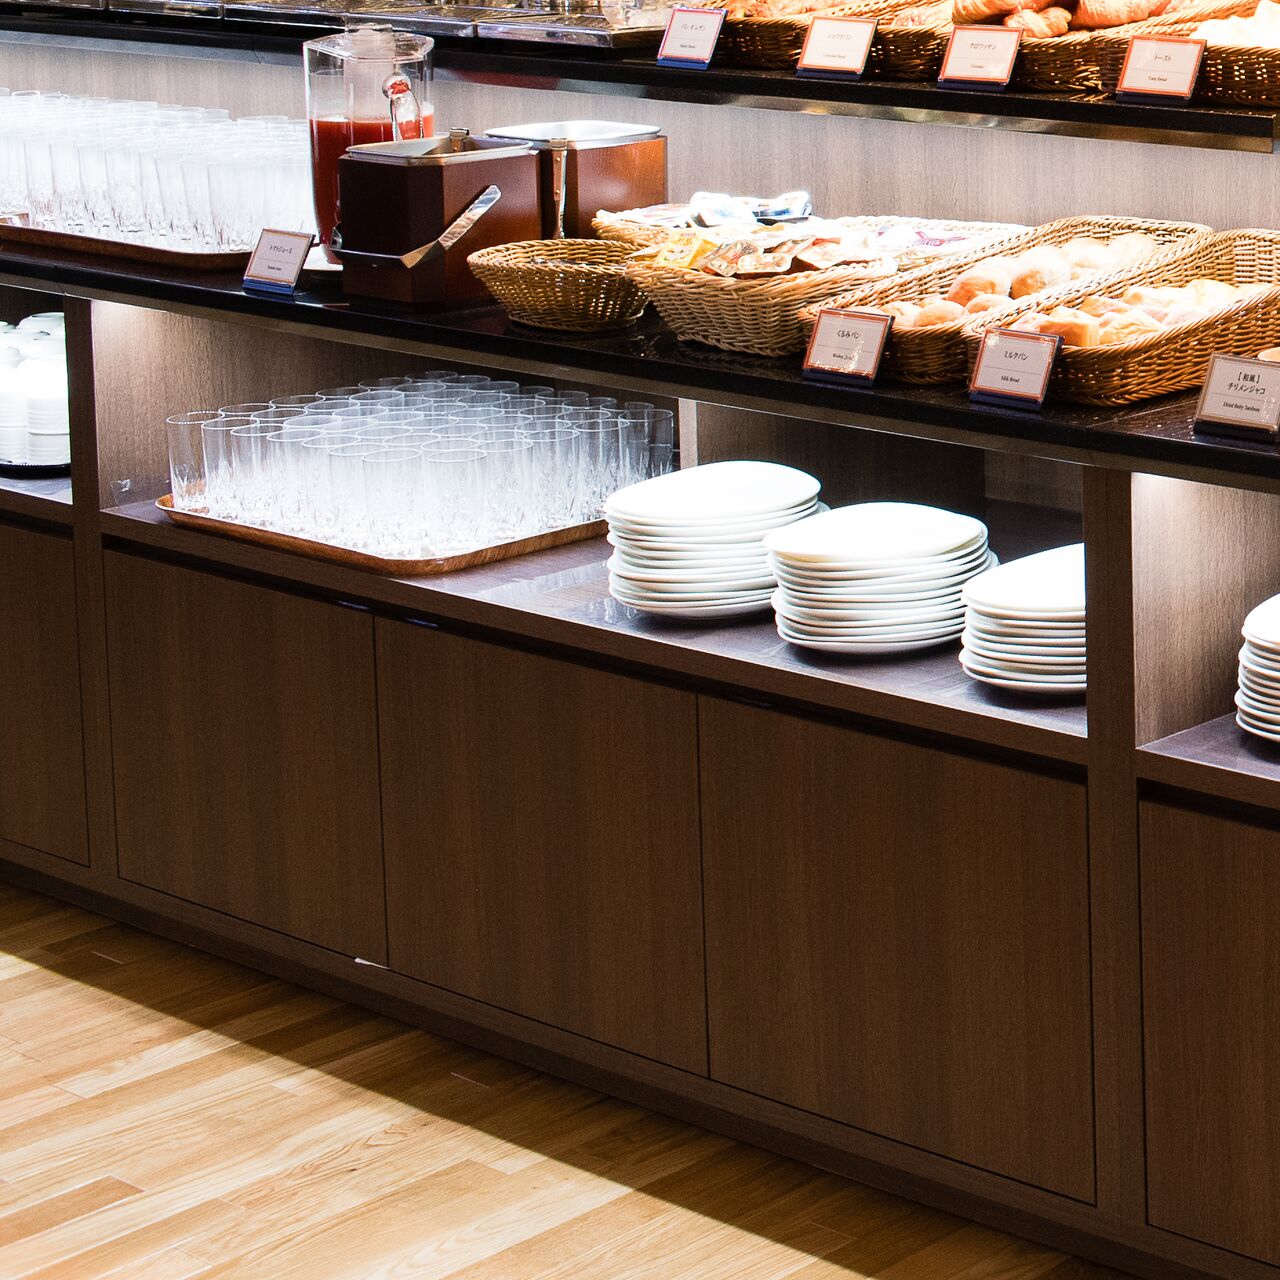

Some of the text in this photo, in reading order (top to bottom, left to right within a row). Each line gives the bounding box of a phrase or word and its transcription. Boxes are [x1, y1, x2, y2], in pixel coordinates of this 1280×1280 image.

[1153, 54, 1172, 62] トースト
[836, 329, 862, 340] くるみパン
[1004, 350, 1029, 362] ミルクパン
[1238, 372, 1261, 384] 【和風】
[1228, 382, 1266, 395] チリメンジャコ
